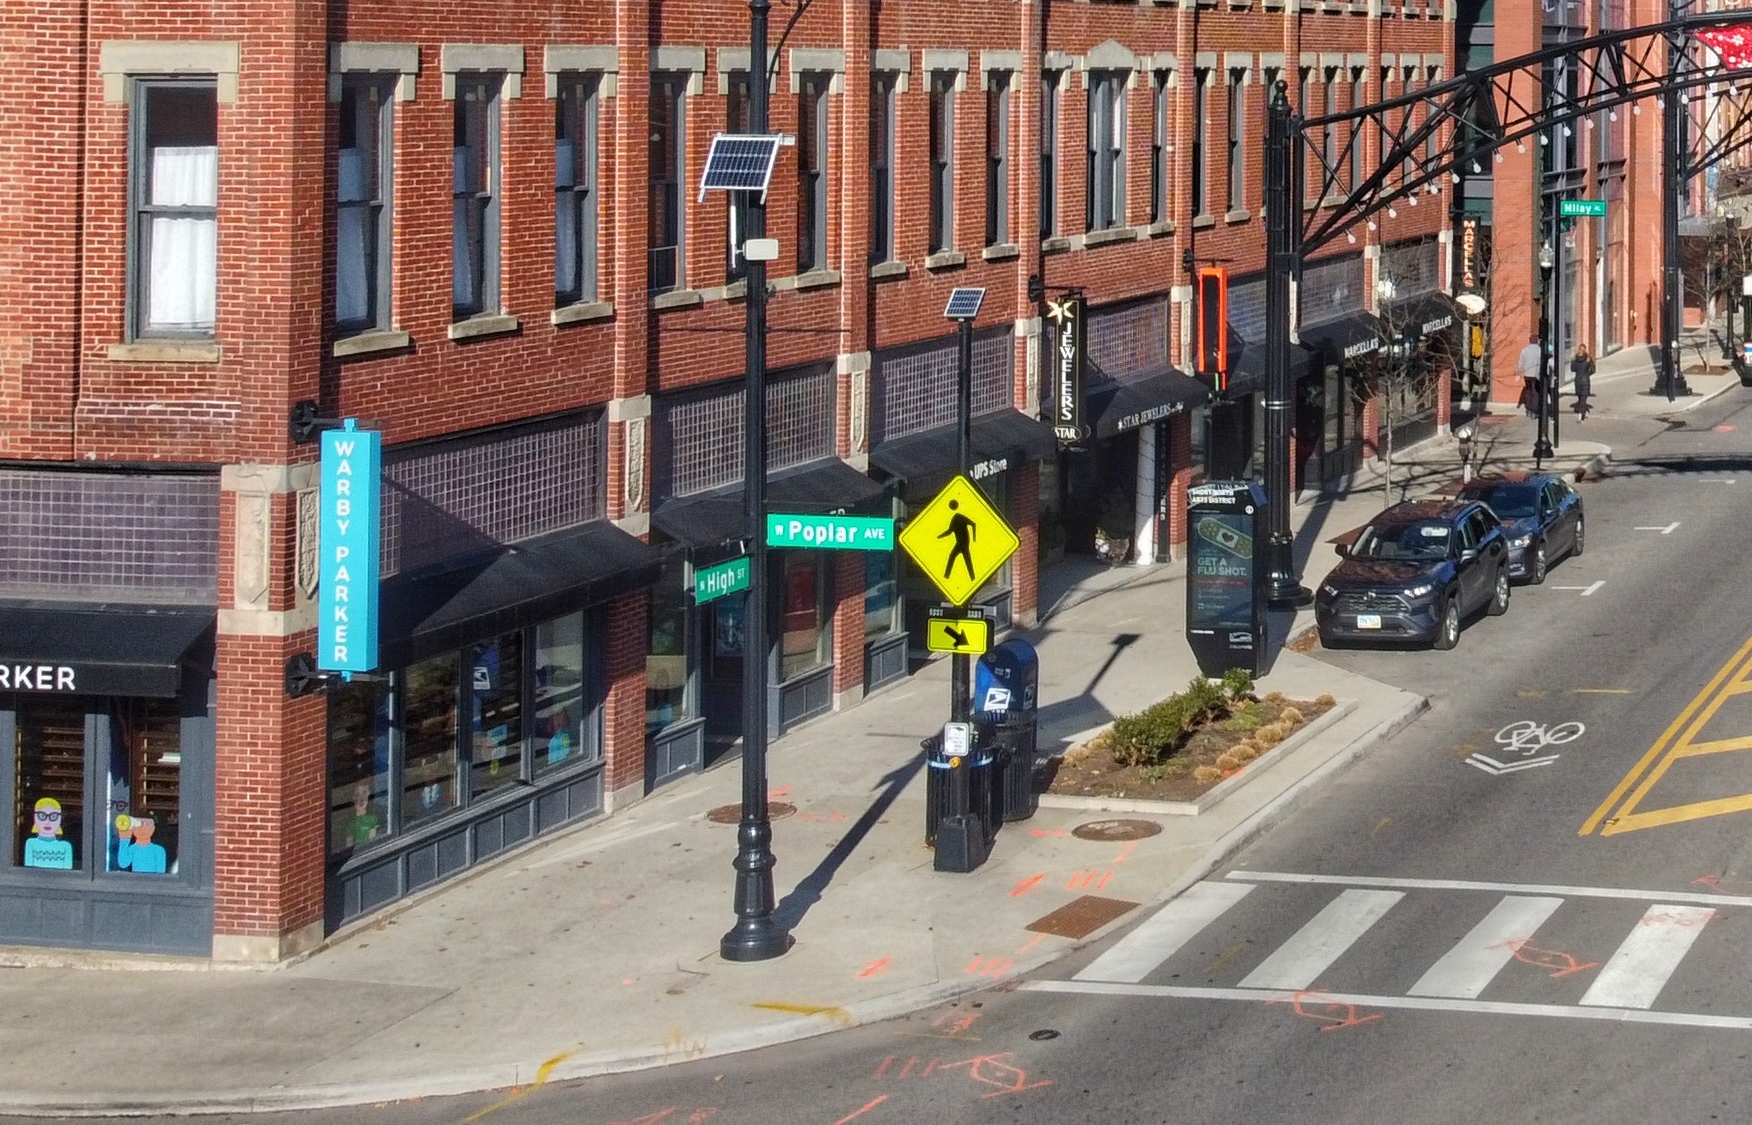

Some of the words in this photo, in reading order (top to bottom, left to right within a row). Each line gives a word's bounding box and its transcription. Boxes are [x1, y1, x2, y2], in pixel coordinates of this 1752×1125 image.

[1060, 322, 1075, 421] JEWELERS
[1054, 427, 1077, 440] STAR
[974, 461, 989, 480] UPS
[989, 458, 1007, 475] Store
[334, 440, 355, 536] WARBY
[1209, 496, 1236, 505] DISTRICT
[788, 520, 858, 545] Poplar
[864, 527, 885, 540] AVE
[1197, 557, 1217, 566] GET
[1219, 557, 1227, 566] A
[1197, 566, 1217, 575] FLU
[707, 567, 735, 594] High
[736, 567, 746, 580] ST
[333, 545, 352, 663] PARKER
